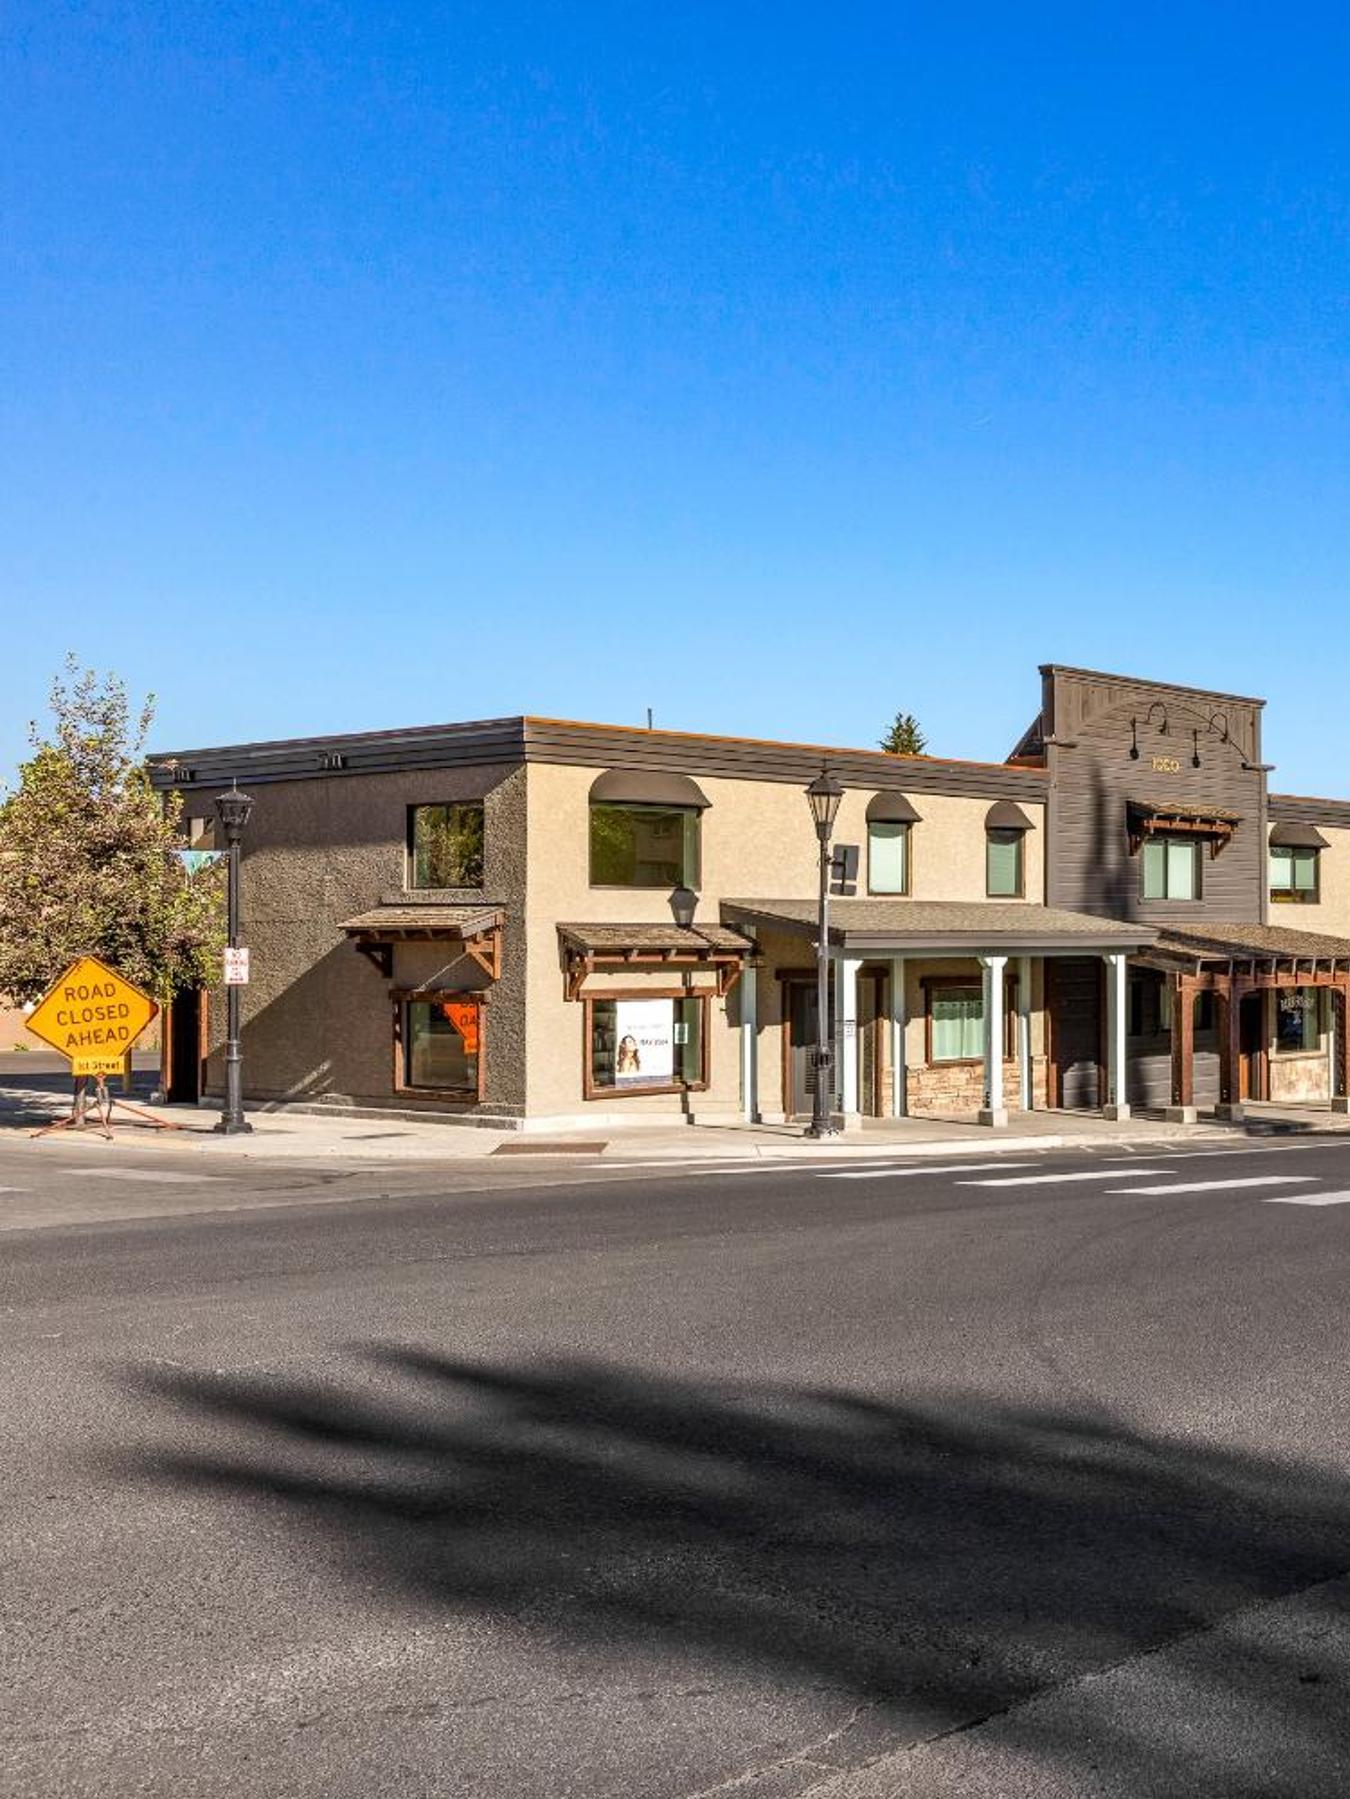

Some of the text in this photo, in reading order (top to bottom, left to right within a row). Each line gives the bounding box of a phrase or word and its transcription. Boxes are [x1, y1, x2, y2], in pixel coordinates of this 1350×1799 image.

[64, 983, 117, 1002] ROAD
[56, 1003, 130, 1027] CLOSED
[65, 1026, 129, 1048] AHEAD
[92, 1060, 120, 1071] Street
